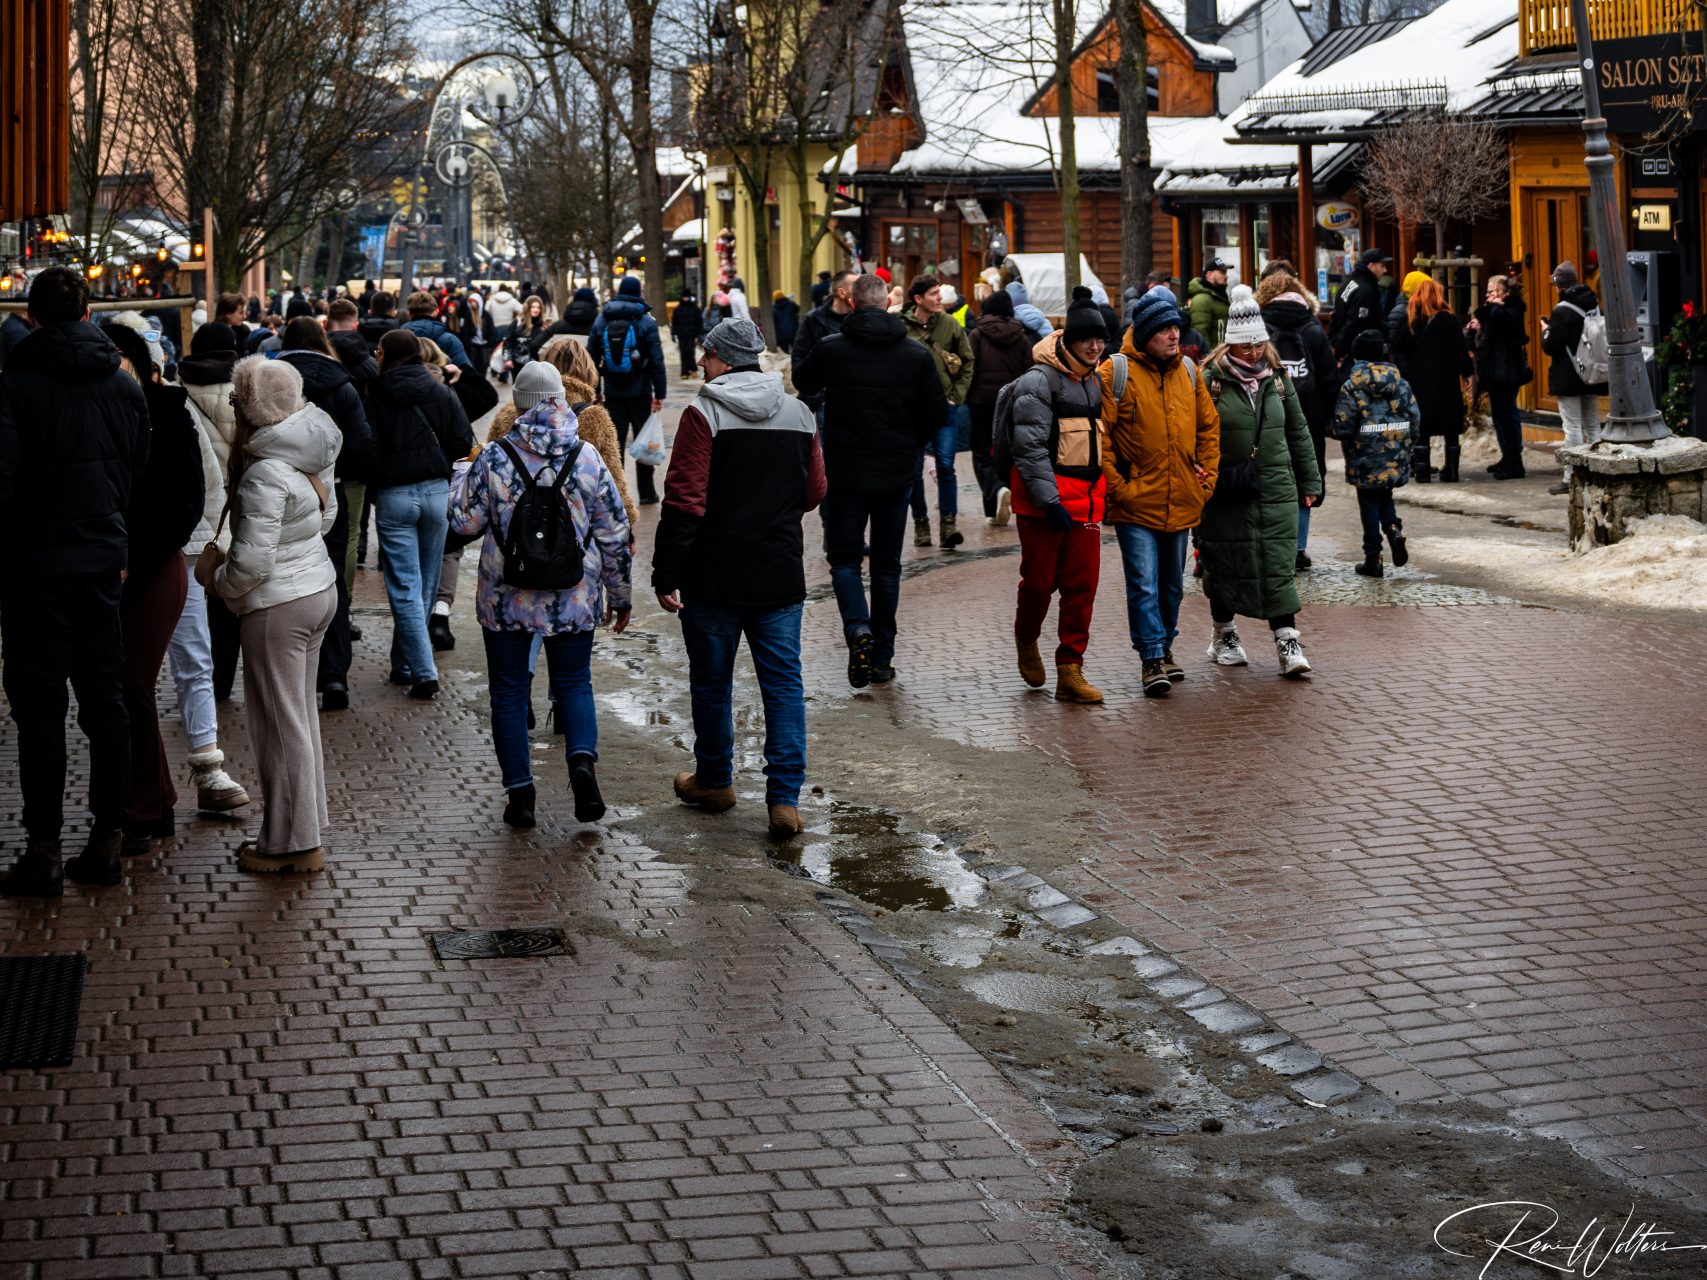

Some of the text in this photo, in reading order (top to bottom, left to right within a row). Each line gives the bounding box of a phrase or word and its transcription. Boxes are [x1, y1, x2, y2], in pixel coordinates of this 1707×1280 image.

[1601, 55, 1707, 89] SALON SZT
[1651, 93, 1687, 110] PRU-AR
[1643, 211, 1660, 225] ATM
[1360, 421, 1411, 433] LIMITLESS DREAMS
